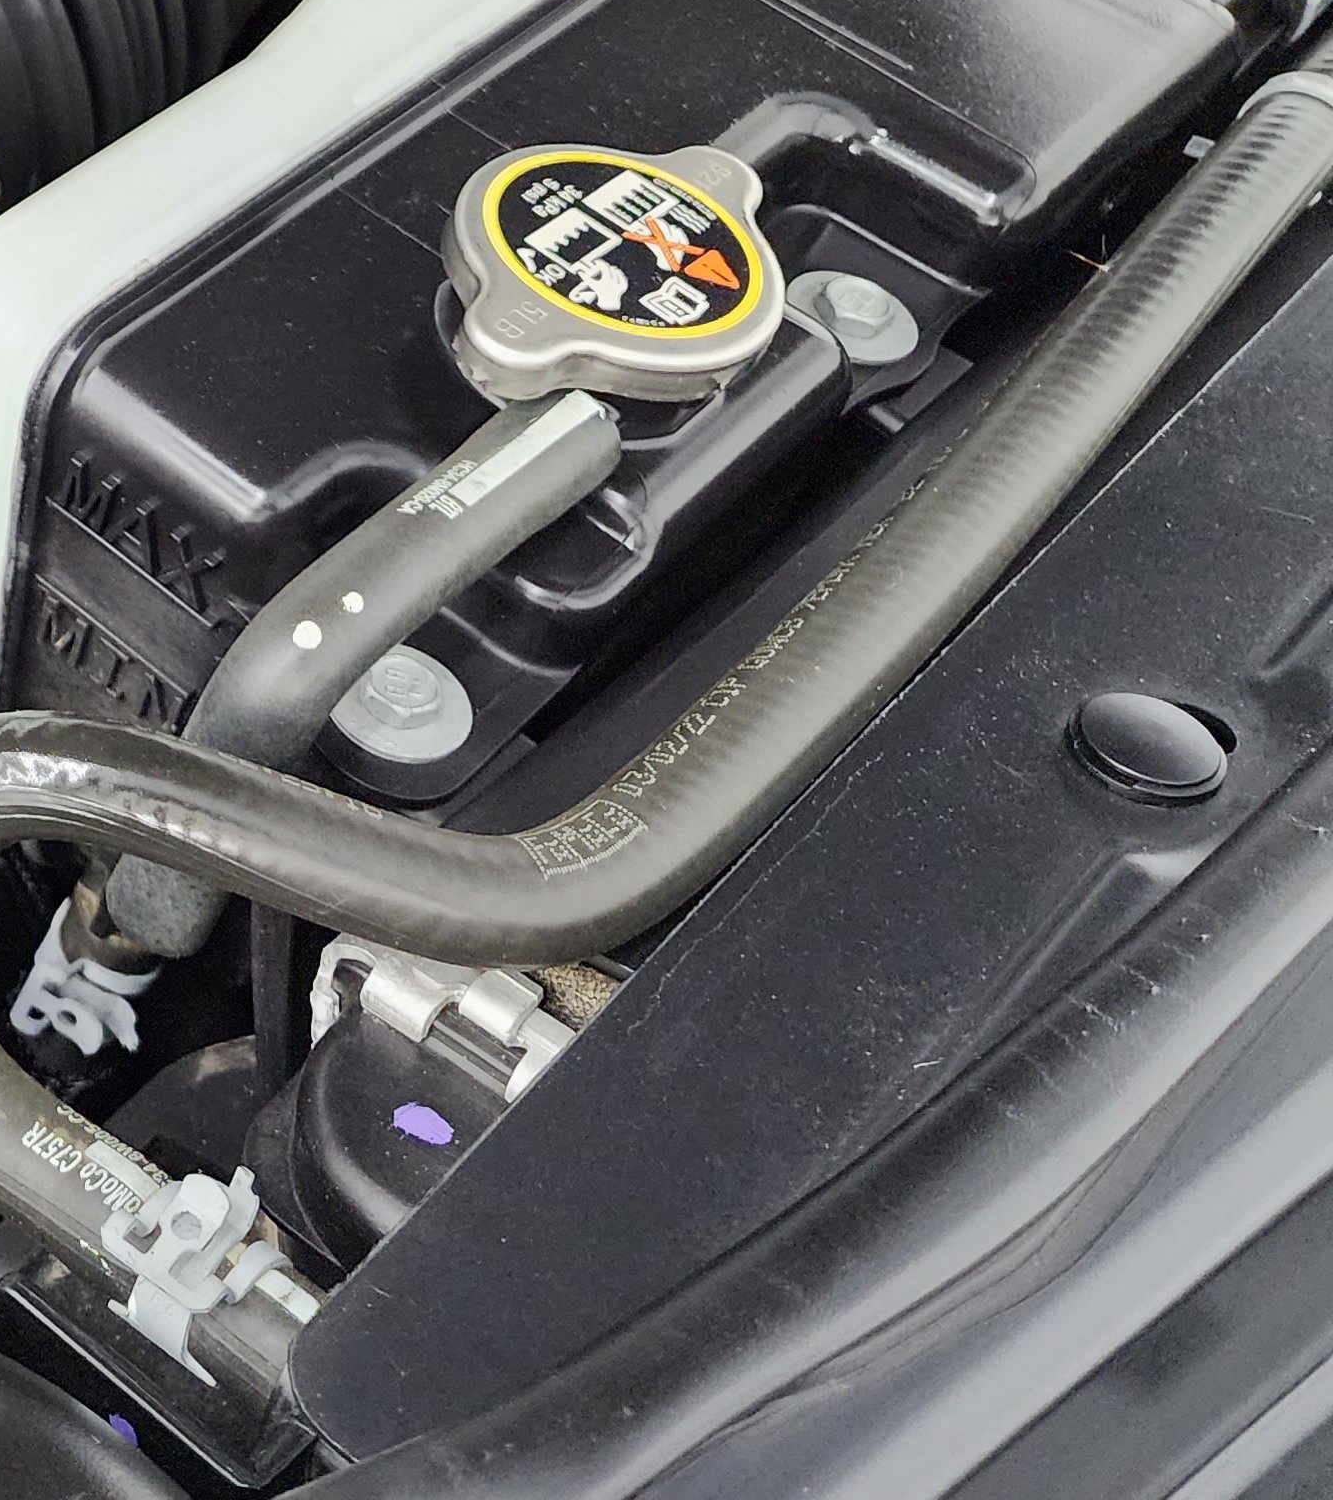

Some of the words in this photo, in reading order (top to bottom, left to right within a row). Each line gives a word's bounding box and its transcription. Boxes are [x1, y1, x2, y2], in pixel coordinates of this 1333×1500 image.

[535, 263, 567, 288] OK
[60, 450, 225, 615] MAX
[37, 592, 187, 737] MIN
[21, 1120, 83, 1174] C757R
[79, 1162, 144, 1214] oMoCo
